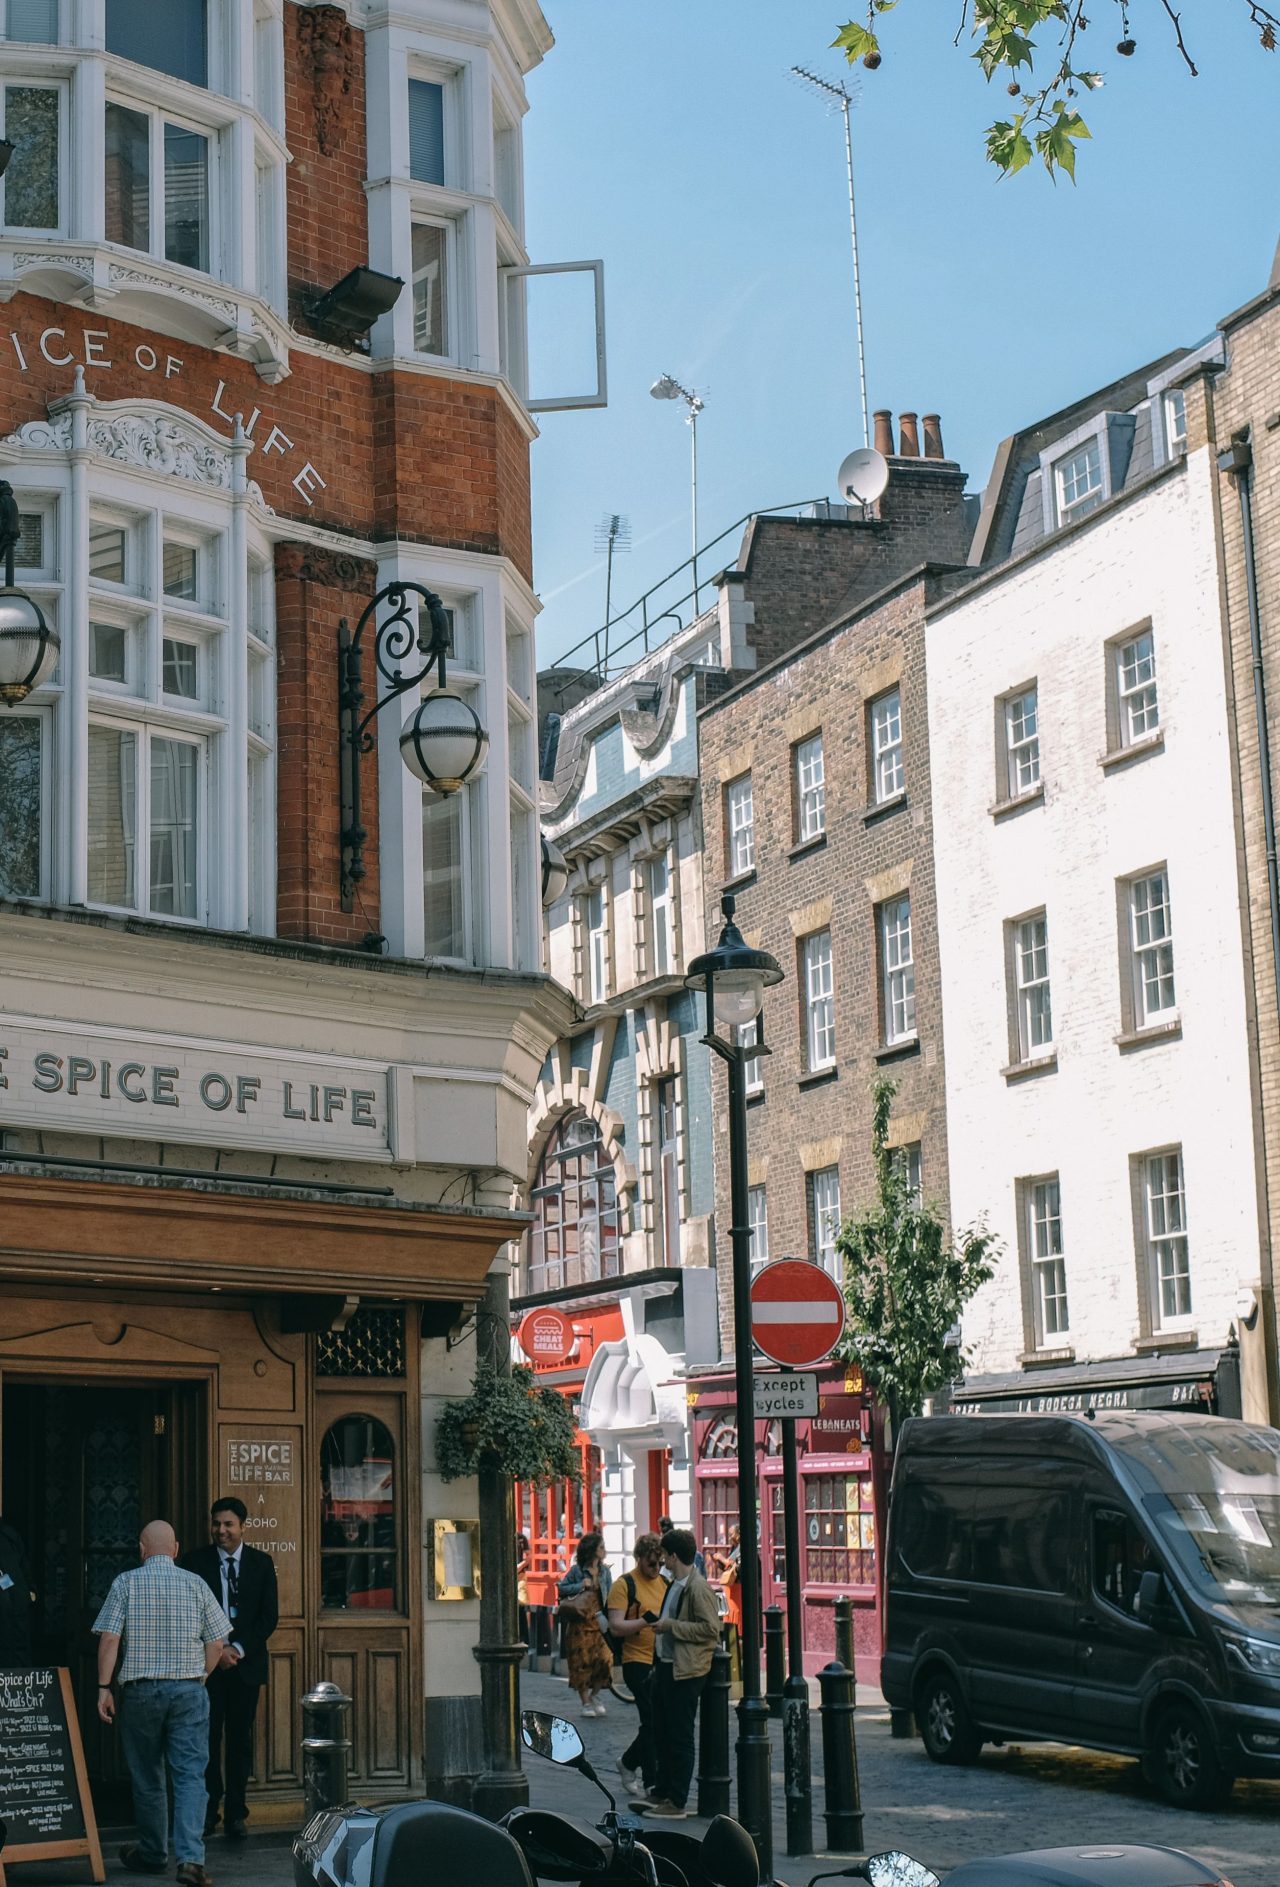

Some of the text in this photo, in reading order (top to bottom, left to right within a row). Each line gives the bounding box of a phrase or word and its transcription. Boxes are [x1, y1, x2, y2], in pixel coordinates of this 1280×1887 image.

[135, 343, 185, 379] OF
[210, 379, 327, 507] LIFE
[32, 1051, 180, 1108] SPICE
[199, 1071, 262, 1114] OF
[282, 1081, 377, 1129] LIFE
[533, 1335, 563, 1343] CHEAT
[533, 1342, 563, 1351] MEALS
[753, 1378, 806, 1393] Except
[756, 1397, 805, 1413] cycles
[1038, 1394, 1082, 1413] BODEGA
[1088, 1391, 1128, 1408] NEGRA
[812, 1419, 861, 1430] LEBANEATS
[230, 1443, 238, 1464] THE
[239, 1444, 291, 1464] SPICE
[230, 1465, 263, 1481] LIFE
[265, 1471, 291, 1481] BAR
[257, 1493, 265, 1504] A
[245, 1517, 278, 1528] SOHO
[24, 1671, 35, 1688] of
[36, 1670, 53, 1689] Life
